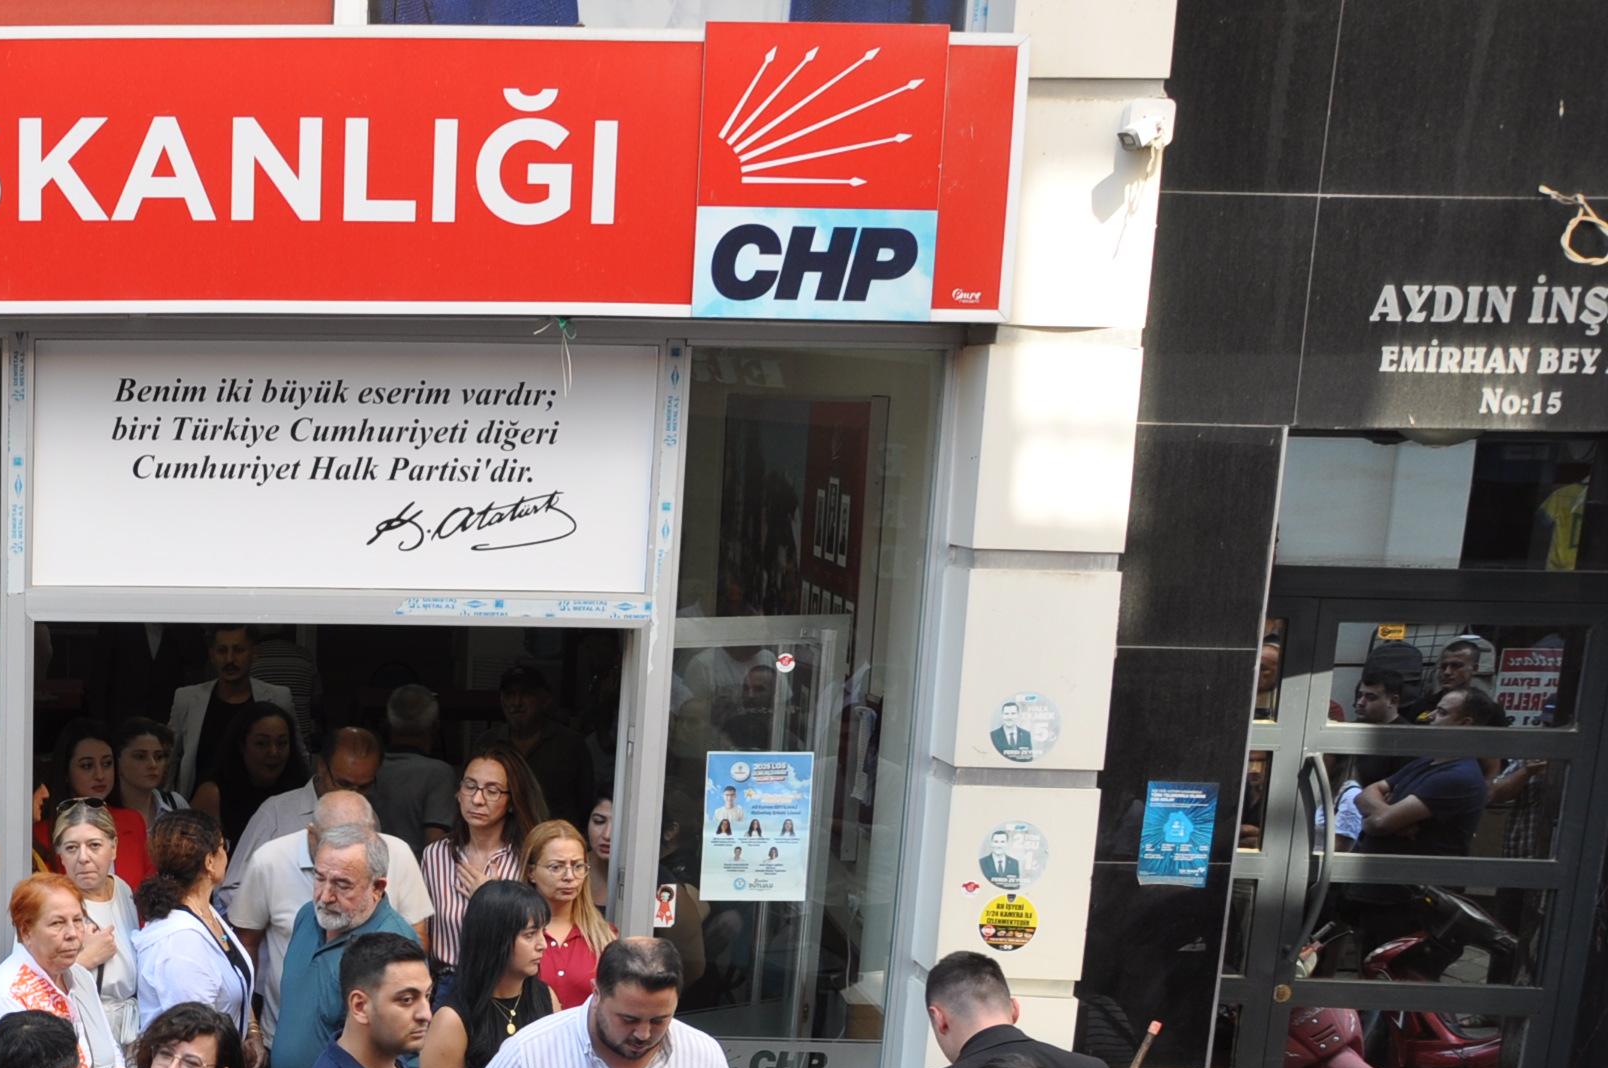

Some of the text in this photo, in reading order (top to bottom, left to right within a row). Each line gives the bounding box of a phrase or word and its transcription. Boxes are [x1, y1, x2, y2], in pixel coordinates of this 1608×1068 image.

[711, 223, 918, 302] CHP
[1368, 274, 1608, 336] AYDIN İNŞ
[1379, 339, 1603, 375] EMİRHAN BEY
[114, 377, 558, 413] Benim iki büyük eserim vardır;
[1478, 387, 1564, 416] No:15
[111, 415, 560, 453] biri Türkiye Cumhuriyeti diğeri
[131, 455, 536, 488] Cumhuriyet Halk Partisi'dir.
